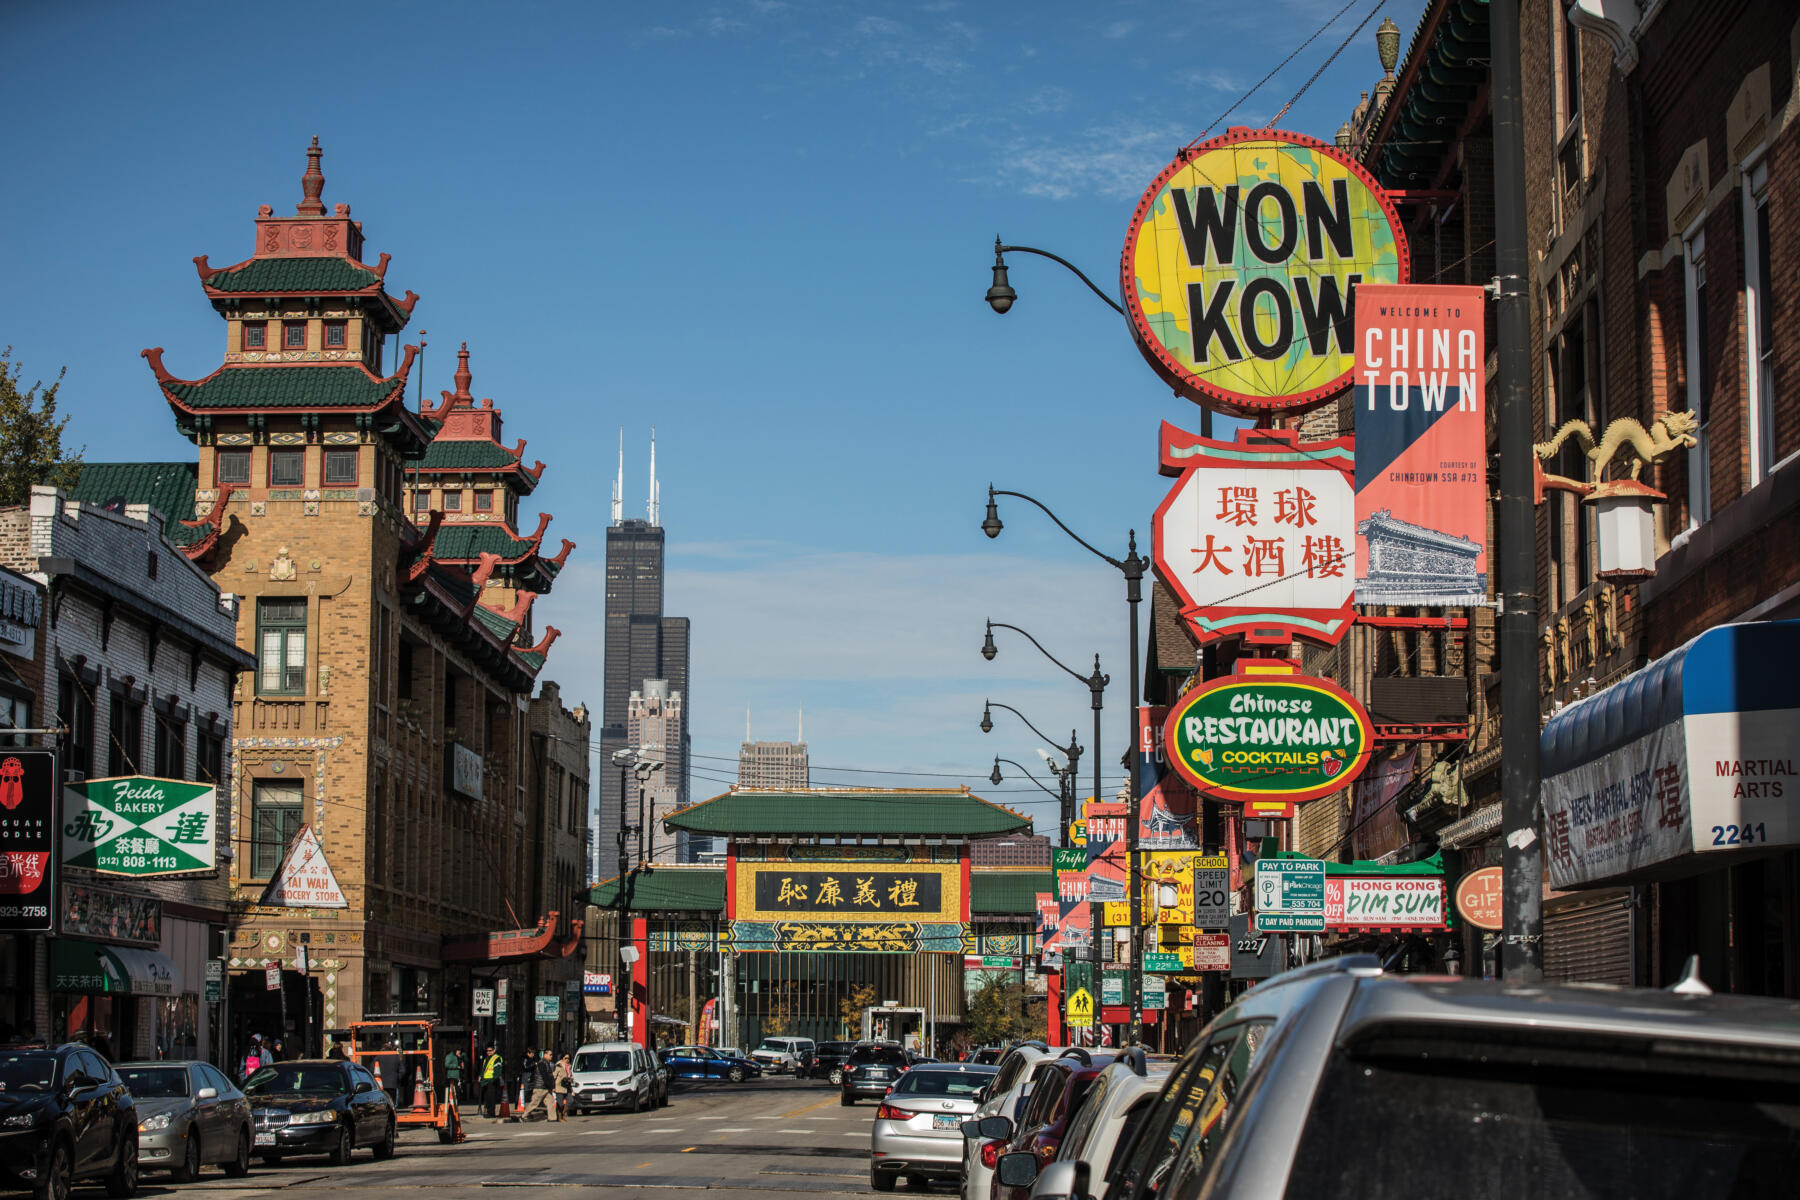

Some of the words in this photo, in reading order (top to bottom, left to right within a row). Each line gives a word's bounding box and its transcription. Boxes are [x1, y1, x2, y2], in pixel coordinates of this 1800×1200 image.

[1170, 179, 1354, 268] WON
[1186, 273, 1363, 365] KOW
[1380, 307, 1438, 317] WELCOME
[1448, 308, 1461, 318] TO
[1365, 328, 1476, 369] CHINA
[1363, 370, 1477, 412] TOWN
[1390, 472, 1438, 482] CHINATOWN
[1441, 472, 1457, 482] SSA
[1461, 473, 1477, 482] #73
[1216, 486, 1318, 528] 環球
[1191, 534, 1347, 579] 大酒樓
[1229, 693, 1312, 714] Chinese
[1185, 716, 1356, 746] RESTAURANT
[1222, 751, 1319, 765] COCKTAILS
[1715, 760, 1799, 777] MARTIAL
[113, 781, 166, 802] Feida
[1733, 781, 1783, 798] ARTS
[115, 803, 165, 813] BAKERY
[1088, 829, 1125, 843] TOWN
[1711, 822, 1766, 846] 2241
[115, 837, 160, 855] 茶餐廳
[98, 856, 119, 866] (312)
[123, 856, 177, 868] 808-1113
[1196, 859, 1226, 867] SCHOOL
[1262, 862, 1279, 871] PAY
[1281, 862, 1294, 871] TO
[1295, 862, 1320, 871] PARK
[1197, 871, 1226, 879] SPEED
[287, 876, 301, 888] TAI
[307, 878, 329, 889] WAH
[1200, 880, 1223, 888] LIMIT
[1351, 881, 1392, 891] HONG
[1395, 881, 1436, 891] KONG
[276, 890, 311, 900] GROCERY
[315, 891, 339, 902] STORE
[1198, 890, 1225, 906] 20
[1326, 883, 1341, 902] %
[1291, 900, 1305, 908] 535
[1308, 900, 1321, 908] 704
[1347, 892, 1389, 914] DIM
[1392, 892, 1442, 915] SUM
[1465, 893, 1502, 907] GIF
[1324, 903, 1344, 917] OFF
[1260, 918, 1264, 926] 7
[1265, 918, 1278, 926] DAY
[1279, 918, 1294, 926] PAID
[1295, 918, 1323, 926] PARKING
[1237, 938, 1268, 956] 2227
[56, 975, 103, 989] 天天茶市
[590, 974, 610, 985] SHOP
